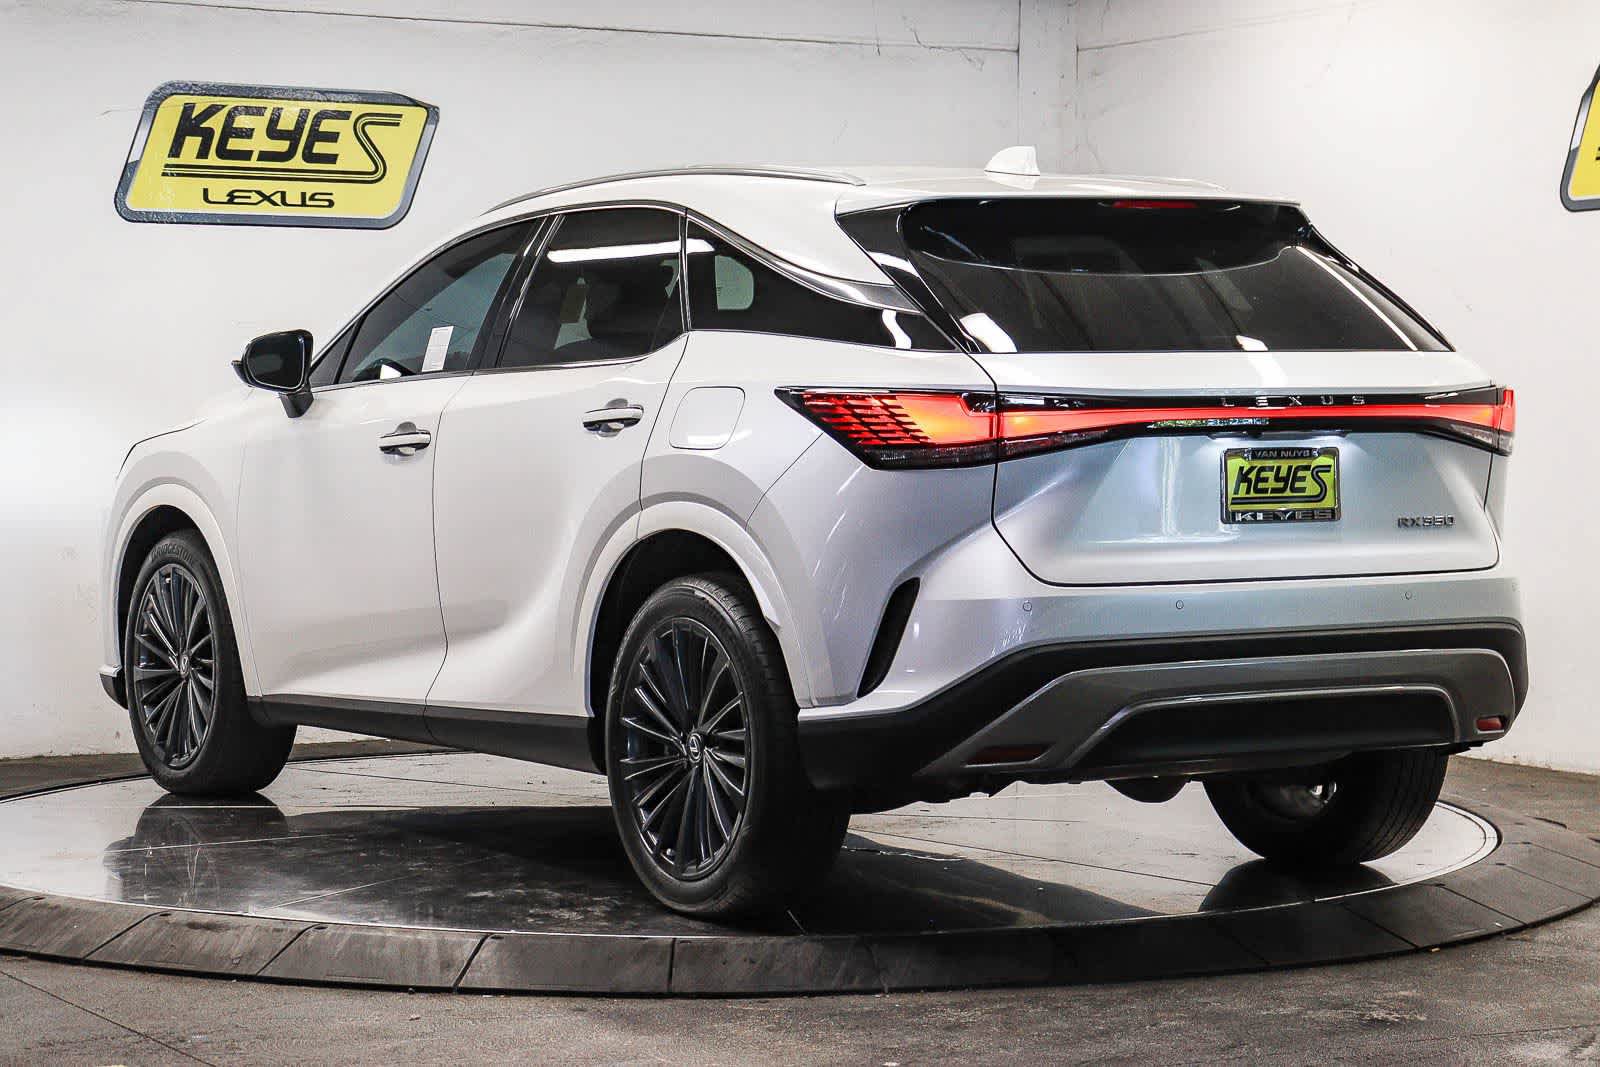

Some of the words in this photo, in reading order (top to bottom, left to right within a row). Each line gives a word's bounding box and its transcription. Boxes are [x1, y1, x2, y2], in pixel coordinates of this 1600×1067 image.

[162, 102, 403, 184] KEYES
[202, 187, 335, 209] LEXUS
[1221, 395, 1366, 407] LEXUS
[1254, 449, 1278, 458] VAN
[1231, 464, 1332, 505] KEYES
[1235, 510, 1332, 521] KEYES
